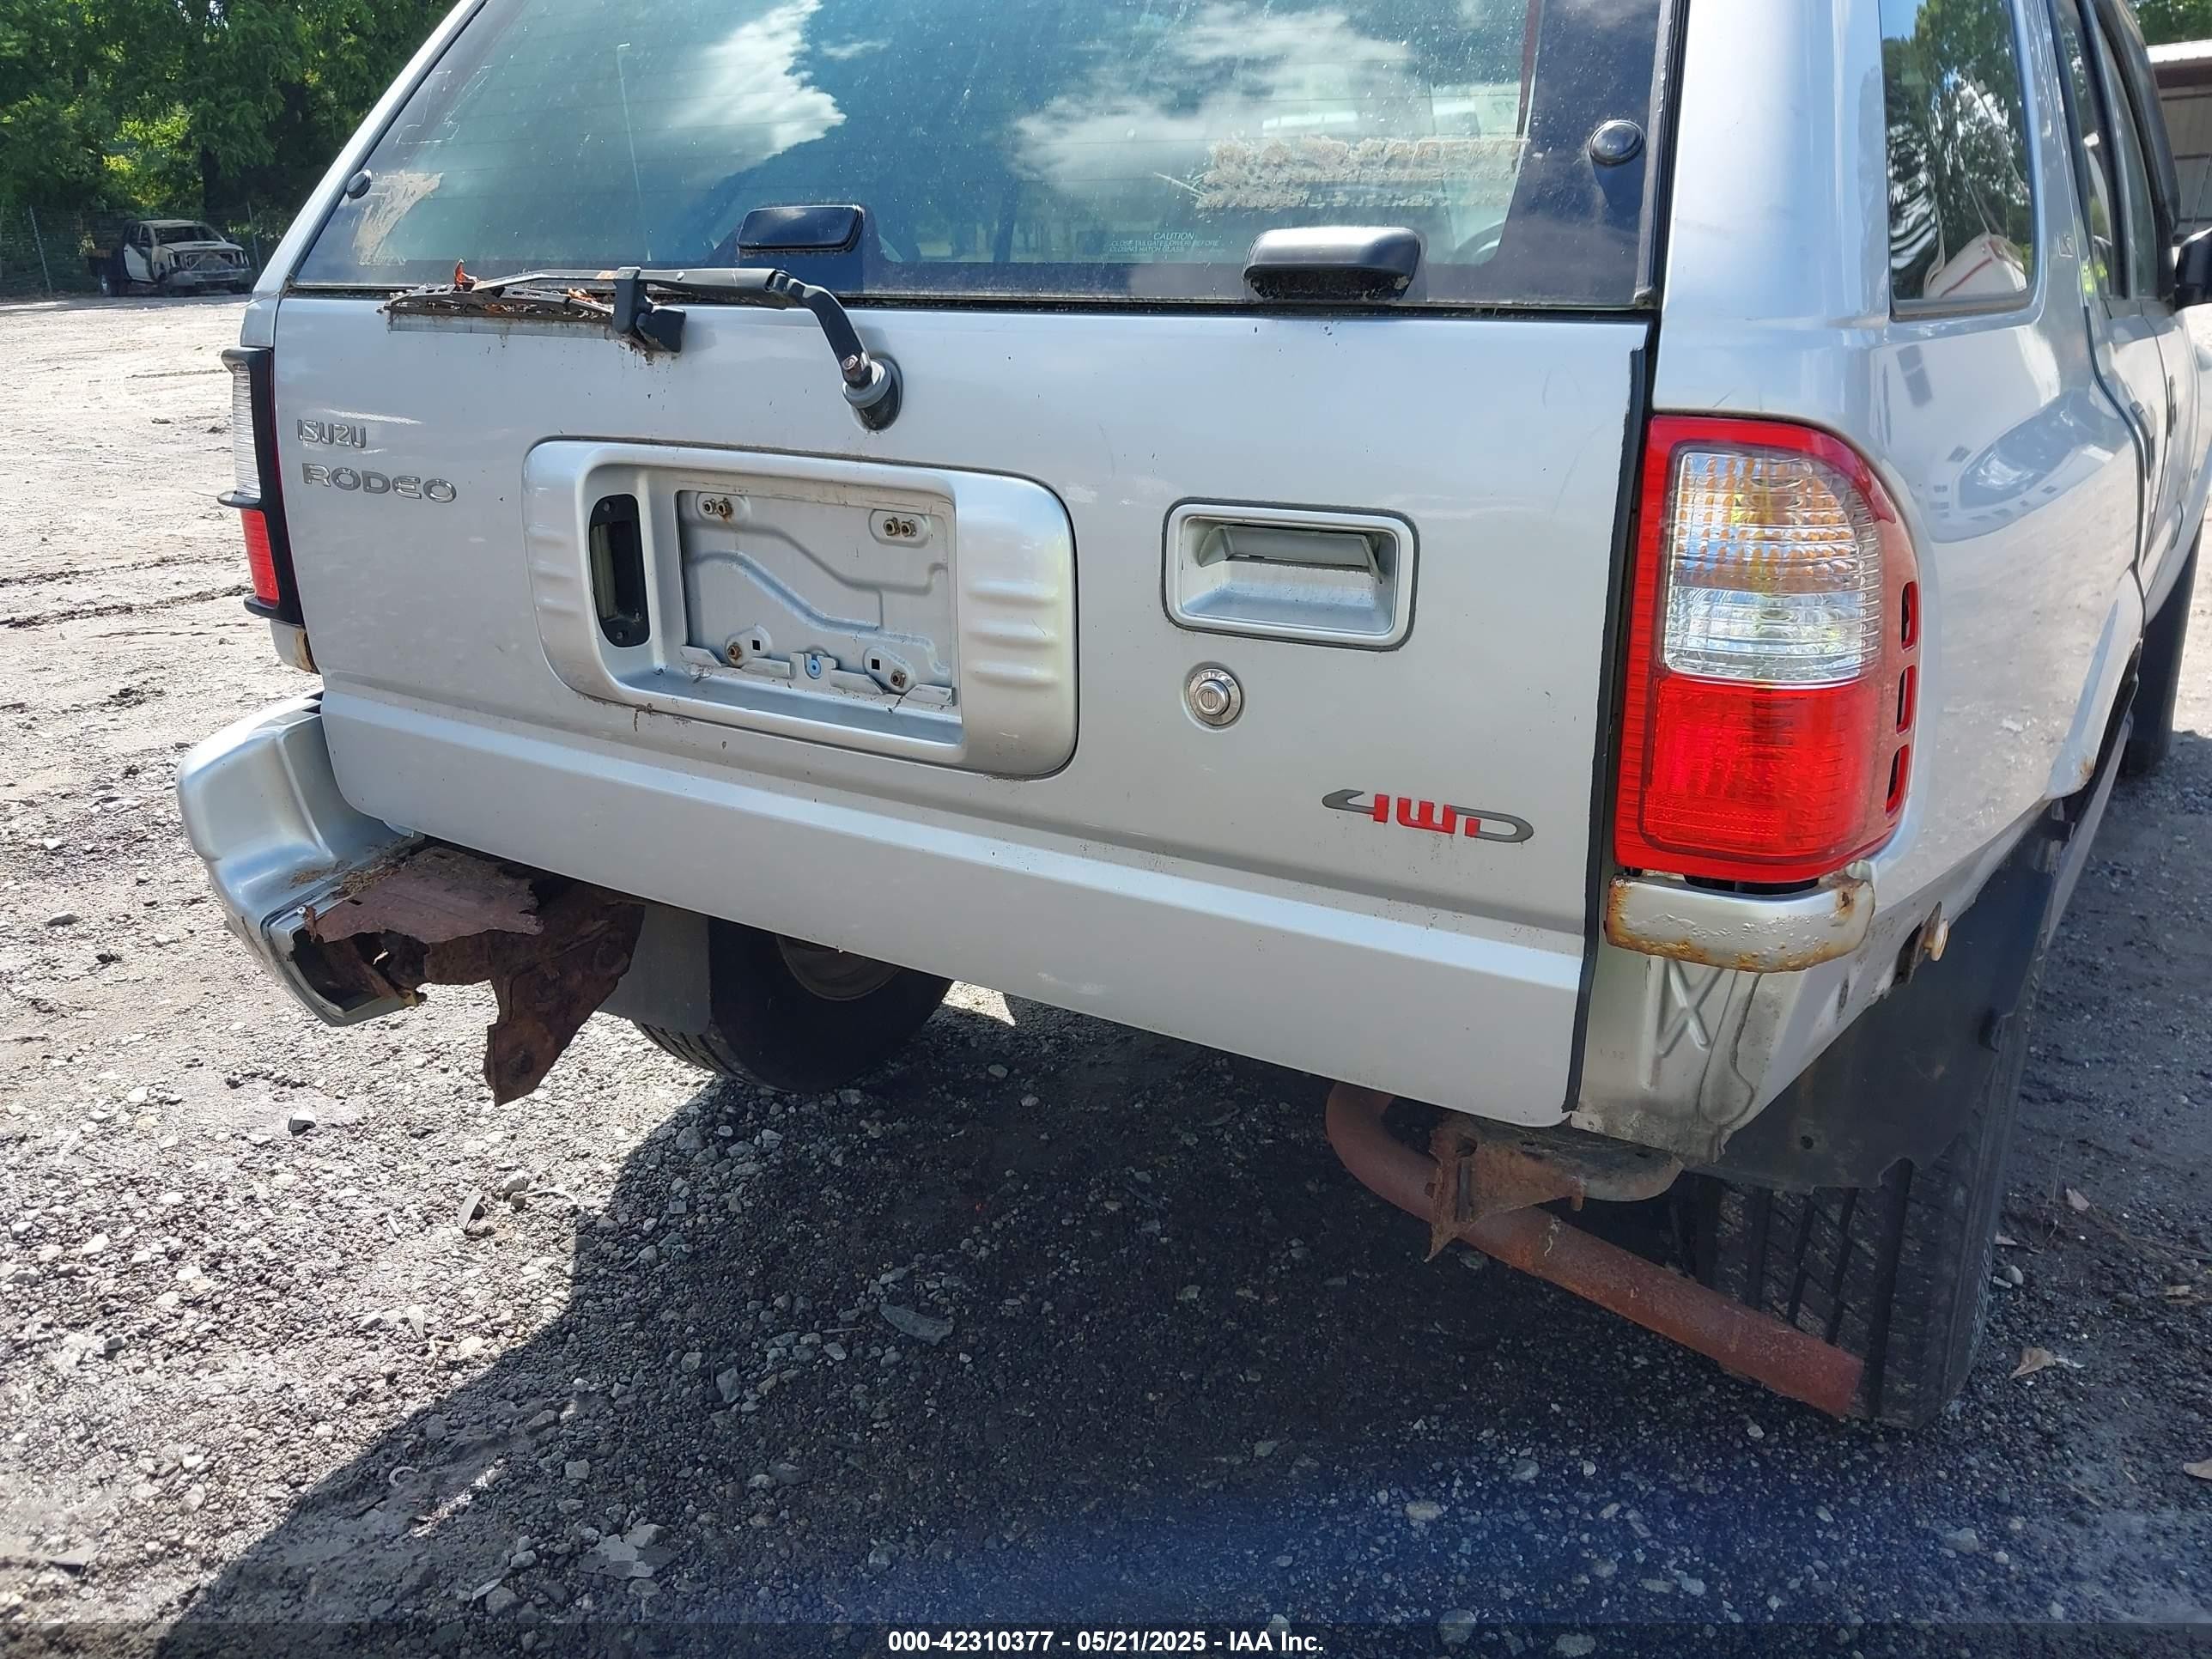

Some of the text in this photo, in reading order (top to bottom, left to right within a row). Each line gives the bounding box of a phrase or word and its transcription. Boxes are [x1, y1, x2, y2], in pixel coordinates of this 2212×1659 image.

[1153, 232, 1194, 240] CAUTION
[297, 419, 367, 449] ISUZU
[302, 463, 457, 503] RODEO
[1322, 789, 1534, 843] 4WD
